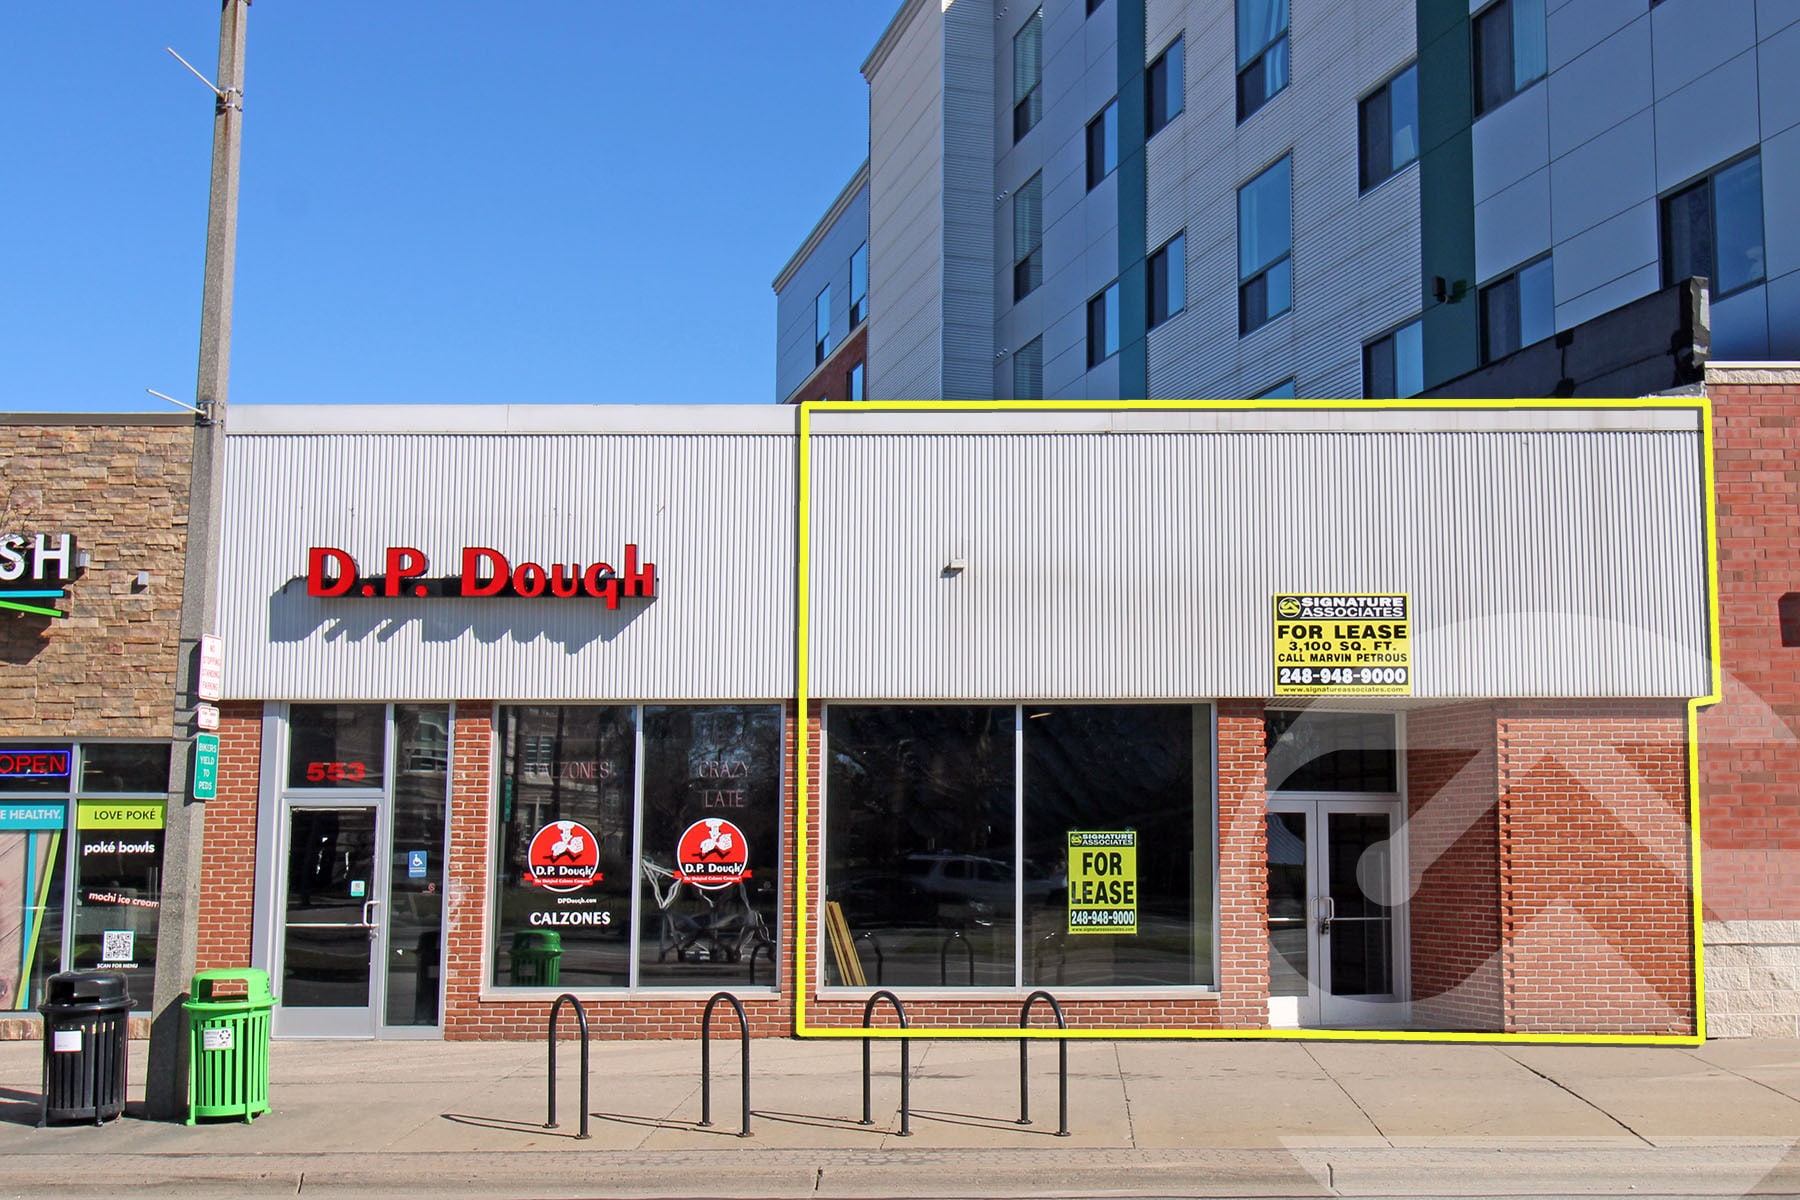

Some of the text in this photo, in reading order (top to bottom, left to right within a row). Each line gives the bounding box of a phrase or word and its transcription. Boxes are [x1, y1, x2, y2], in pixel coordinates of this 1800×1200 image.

[307, 544, 655, 610] D.P. Dough
[1301, 597, 1403, 607] SIGNATURE
[1301, 607, 1403, 617] ASSOCIATES
[1278, 625, 1407, 639] FOR LEASE
[1289, 641, 1397, 652] 3,100 SQ. FT.
[1278, 653, 1407, 662] CALL MARVIN PETROUS
[1280, 668, 1406, 684] 248-948-9000
[0, 755, 66, 773] OPEN
[698, 760, 750, 778] CRAZY
[306, 762, 366, 781] 553
[705, 790, 744, 807] LATE
[9, 809, 61, 820] HEALTHY.
[94, 808, 156, 820] LOVE POKÉ
[84, 841, 155, 856] poké bowls
[536, 865, 592, 877] D.P. Dough
[686, 862, 740, 874] D.P. Dough
[1083, 852, 1122, 876] FOR
[88, 892, 116, 903] mochi
[117, 894, 131, 905] ice
[1071, 880, 1134, 905] LEASE
[529, 911, 611, 925] CALZONES
[1071, 910, 1134, 925] 248-948-9000
